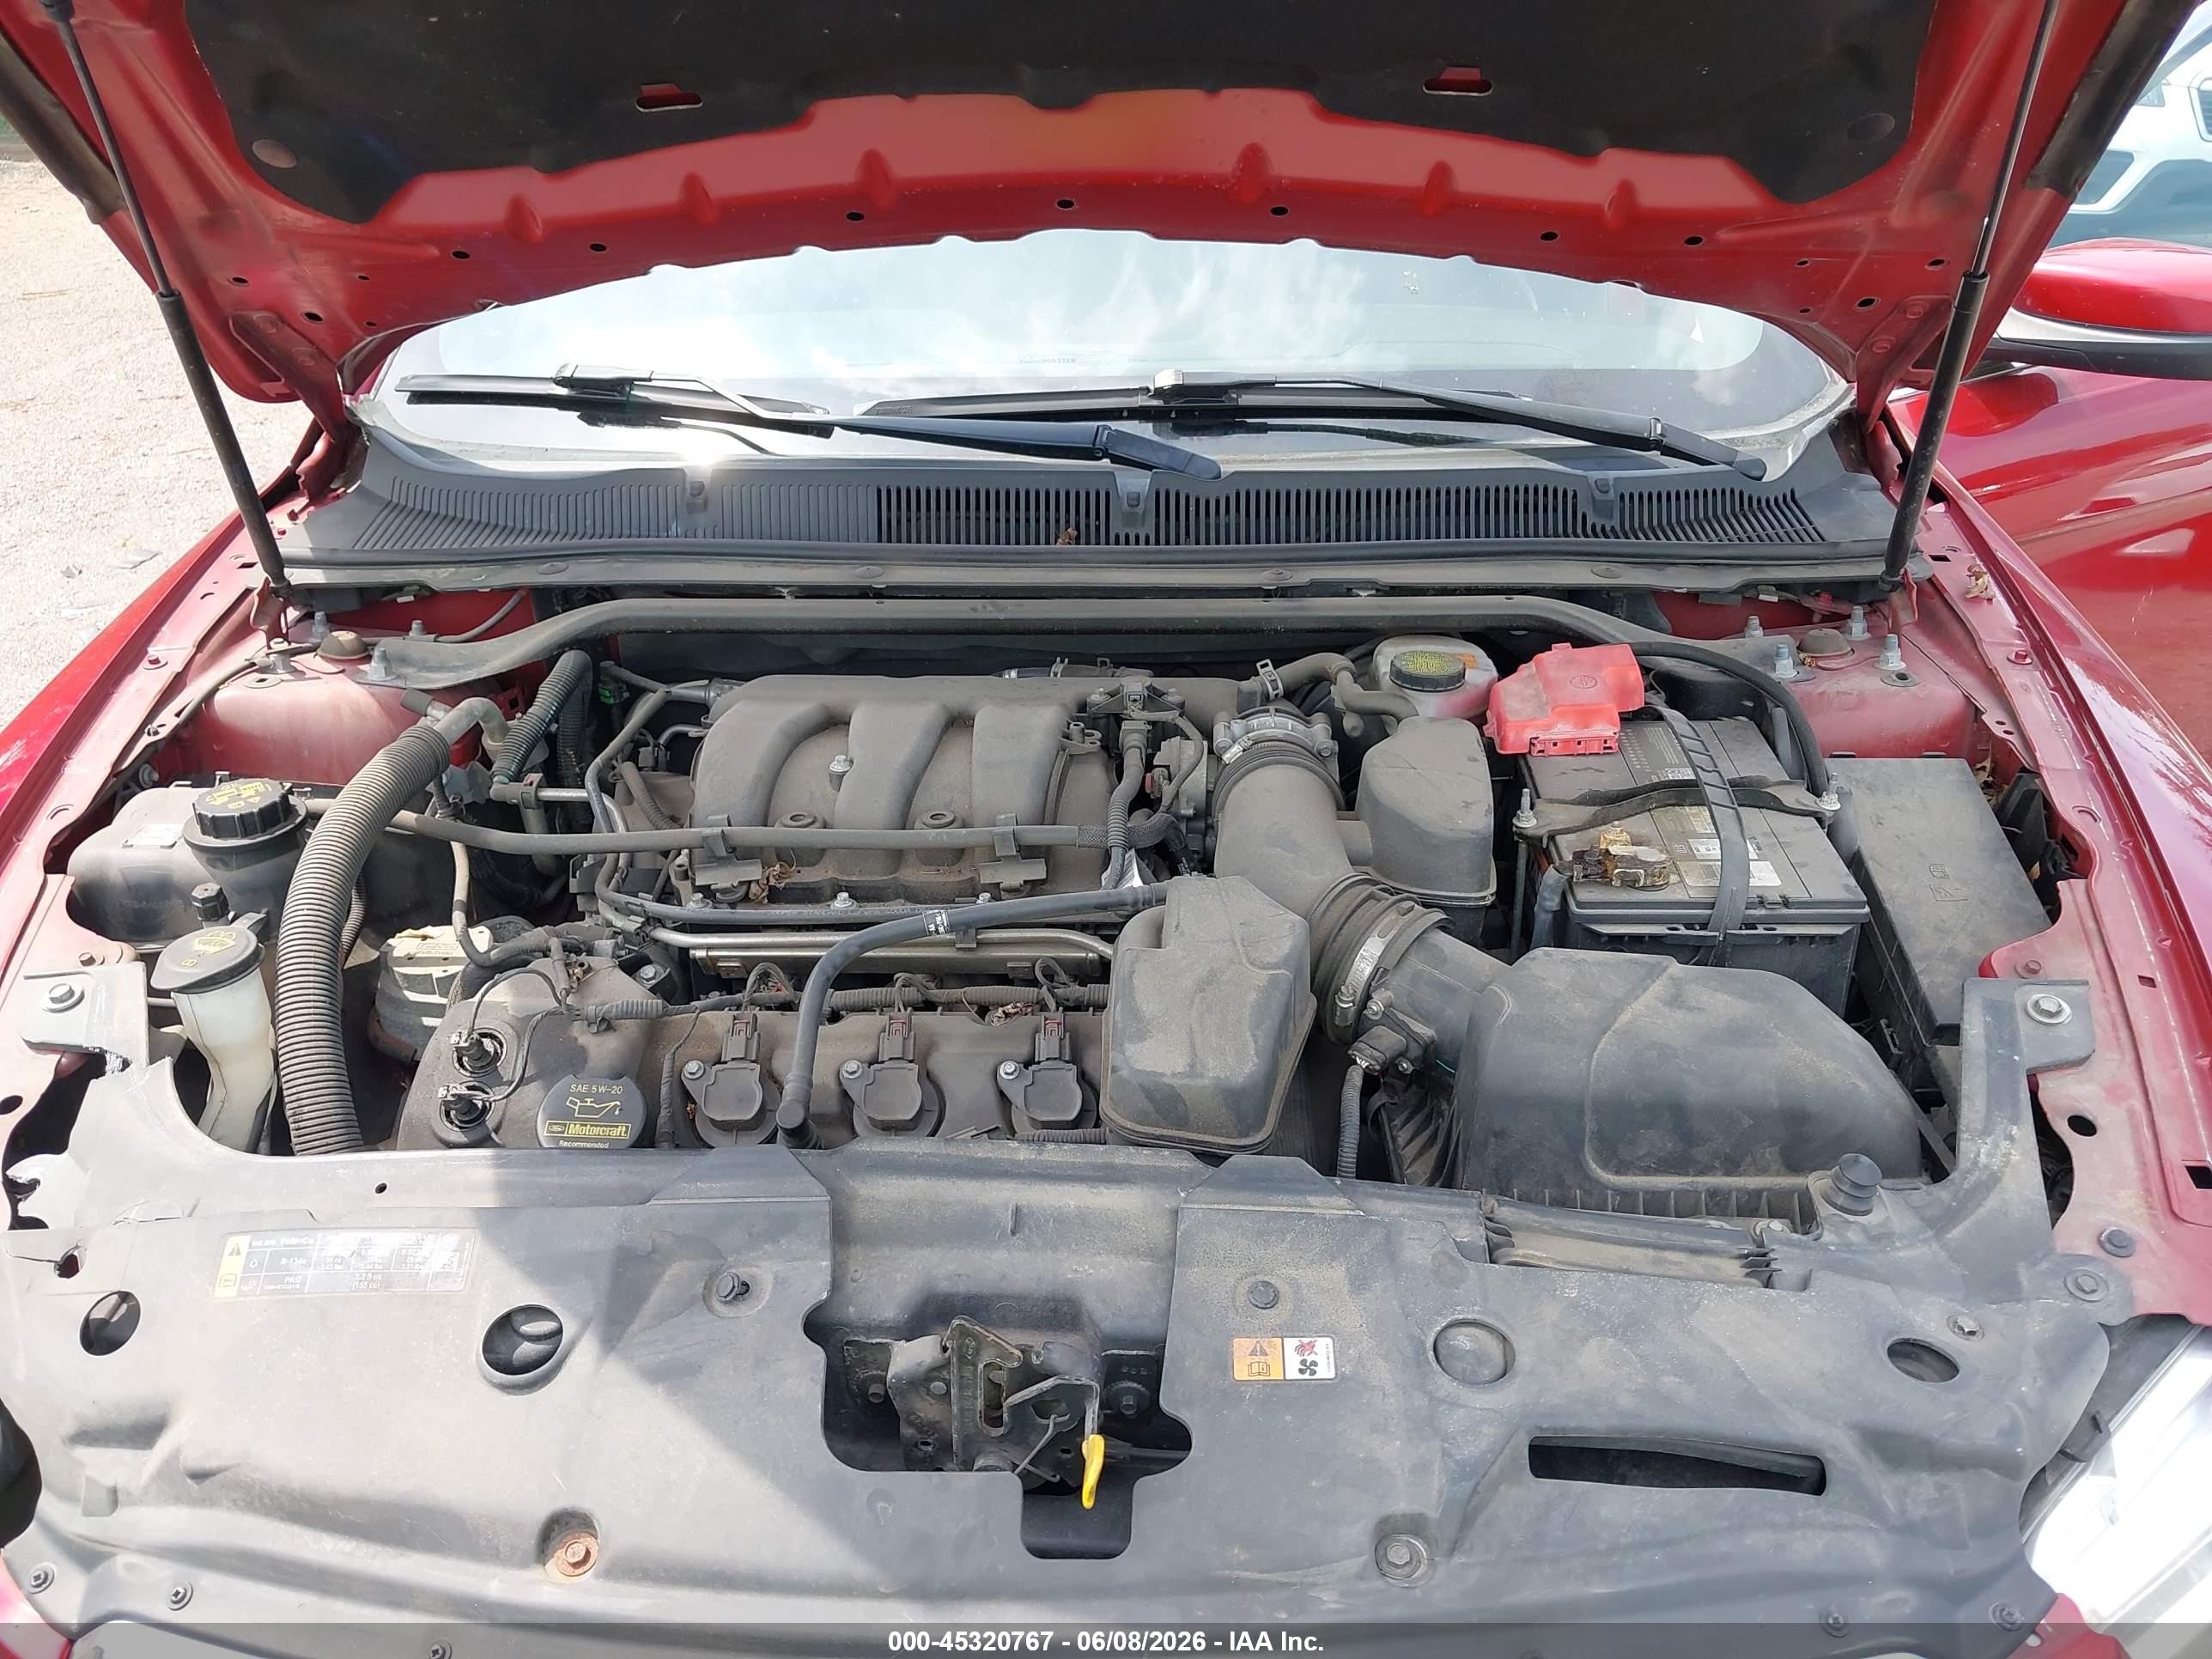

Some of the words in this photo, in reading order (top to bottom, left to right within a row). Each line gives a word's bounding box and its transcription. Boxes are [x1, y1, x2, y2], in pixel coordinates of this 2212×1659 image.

[570, 1084, 589, 1093] SAE
[591, 1085, 623, 1094] 5W-20
[559, 1139, 609, 1149] Recommended
